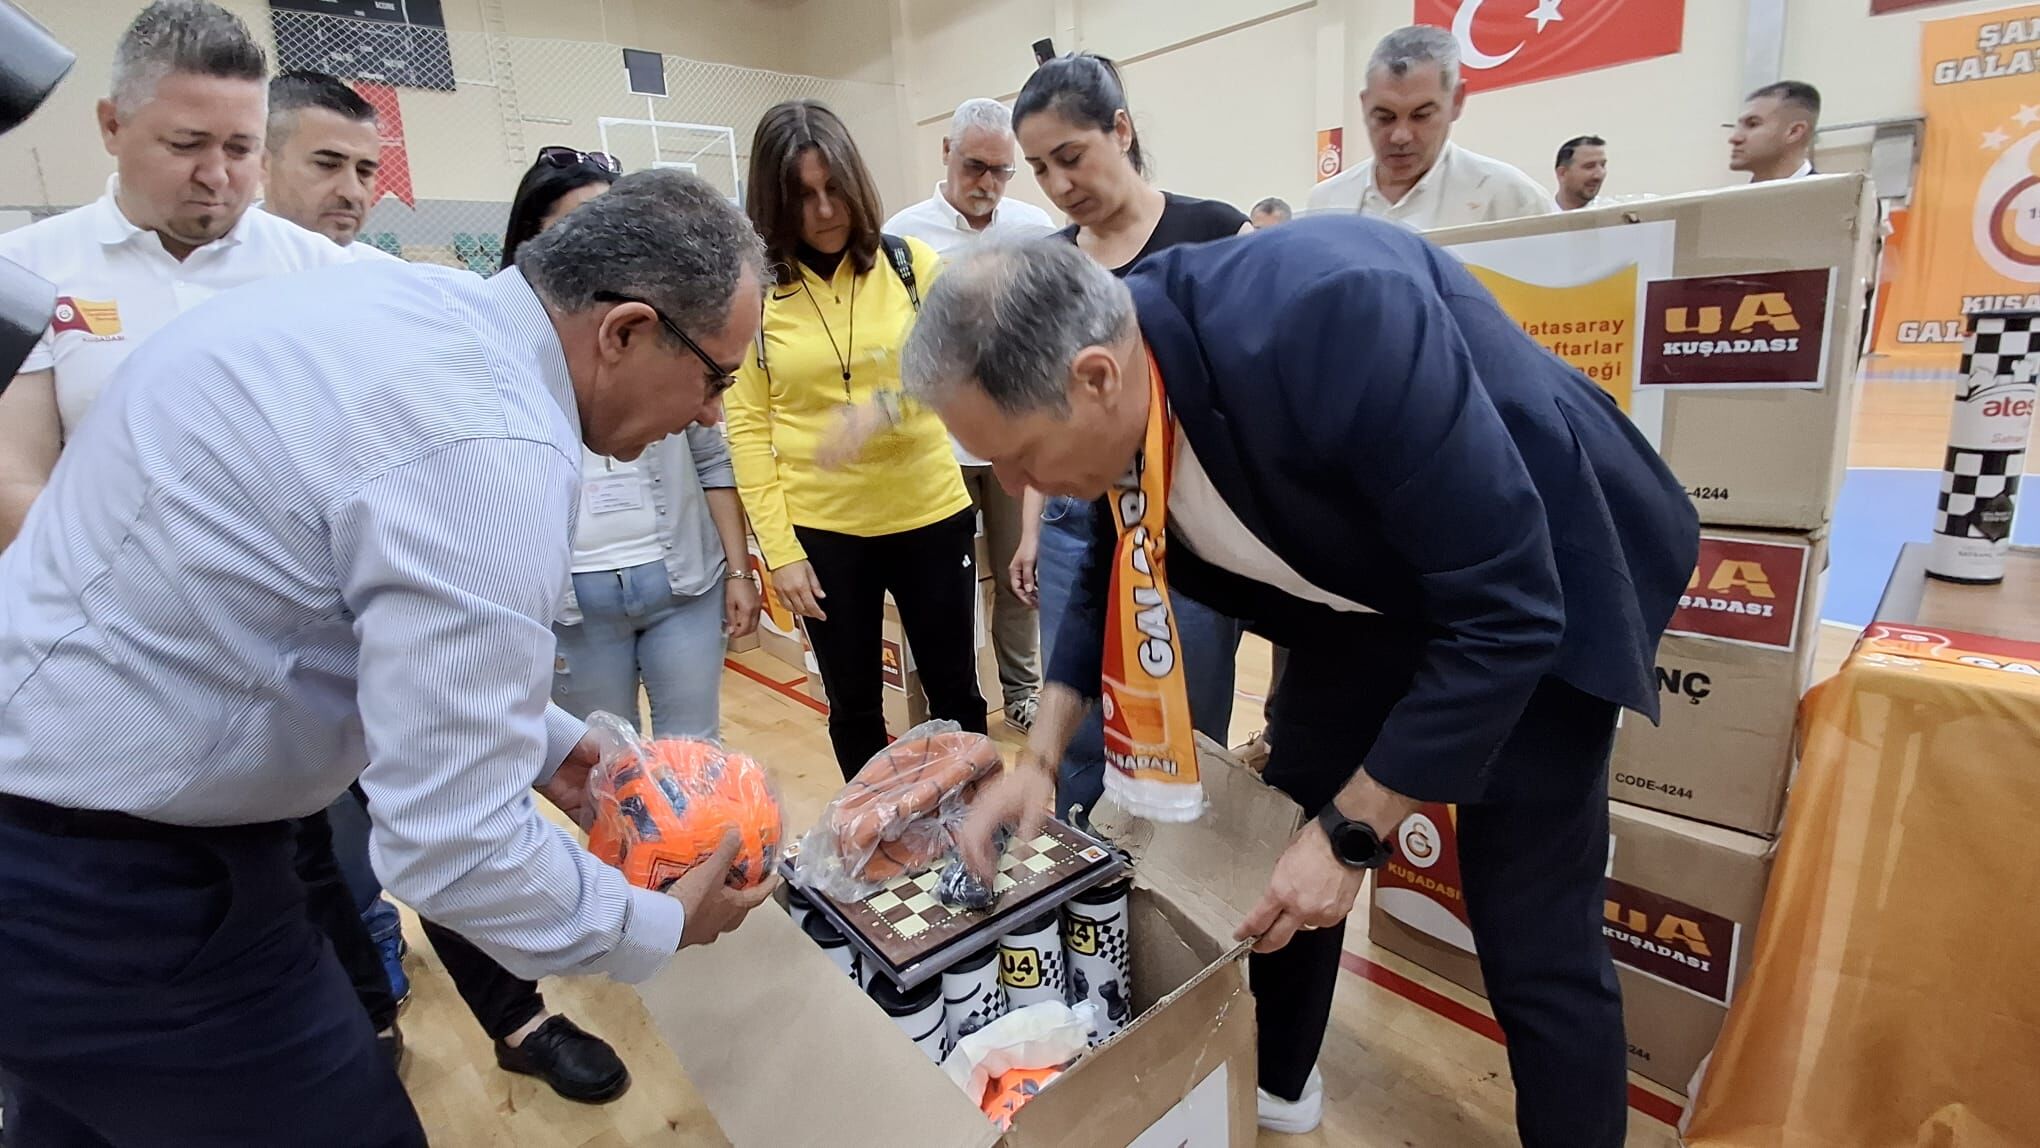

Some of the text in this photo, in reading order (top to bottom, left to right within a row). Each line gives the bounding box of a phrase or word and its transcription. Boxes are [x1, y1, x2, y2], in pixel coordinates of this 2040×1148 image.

[1933, 48, 2040, 86] GALA
[1662, 337, 1800, 358] KUŞADASI
[1655, 665, 1712, 706] NÇ
[1615, 772, 1694, 800] CODE-4244
[1000, 951, 1034, 976] U4
[1602, 925, 1711, 972] KUŞADASI
